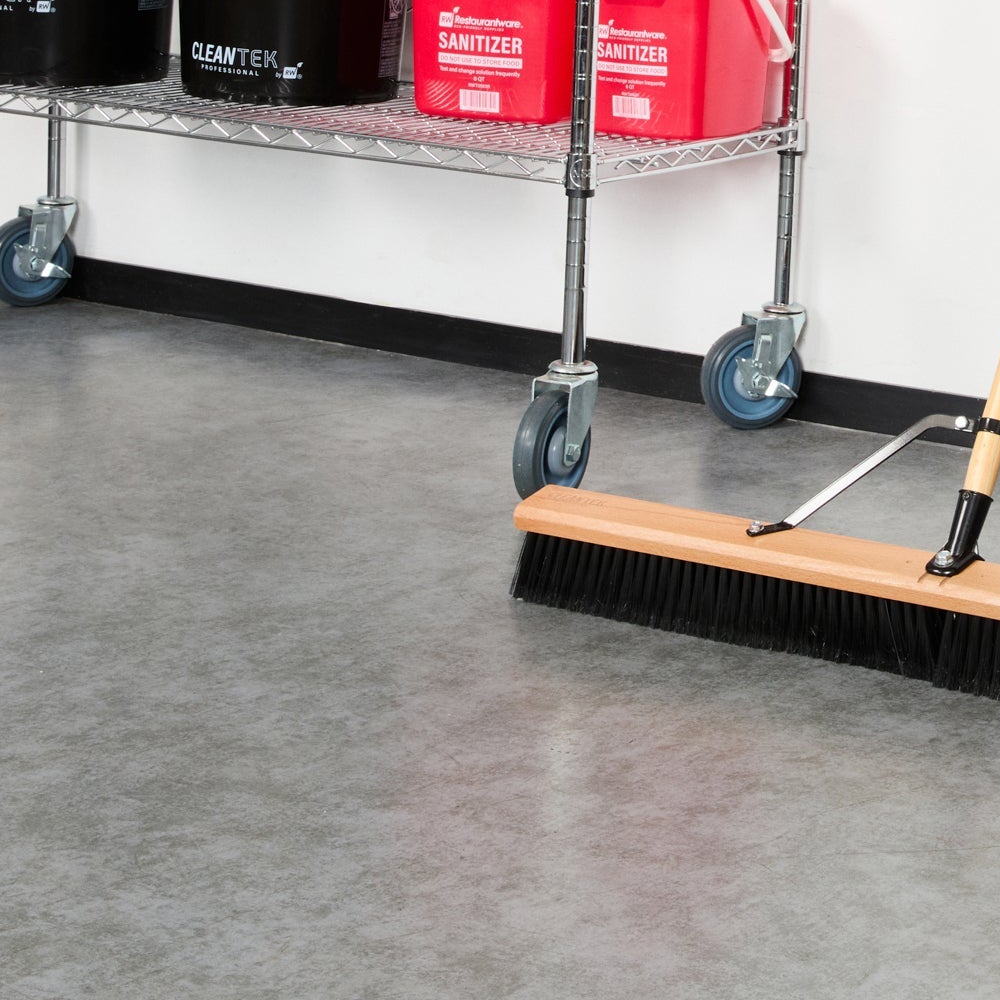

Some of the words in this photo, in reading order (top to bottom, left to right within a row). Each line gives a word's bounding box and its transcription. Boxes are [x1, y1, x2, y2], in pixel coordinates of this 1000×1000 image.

[454, 15, 522, 28] Restaurantware
[610, 27, 665, 39] Restaurantware
[439, 31, 523, 54] SANITIZER
[191, 41, 278, 69] CLEANTEK
[597, 41, 668, 62] SANITIZER
[200, 63, 259, 77] PROFESSIONAL
[284, 68, 297, 78] RW
[495, 70, 520, 78] frequently
